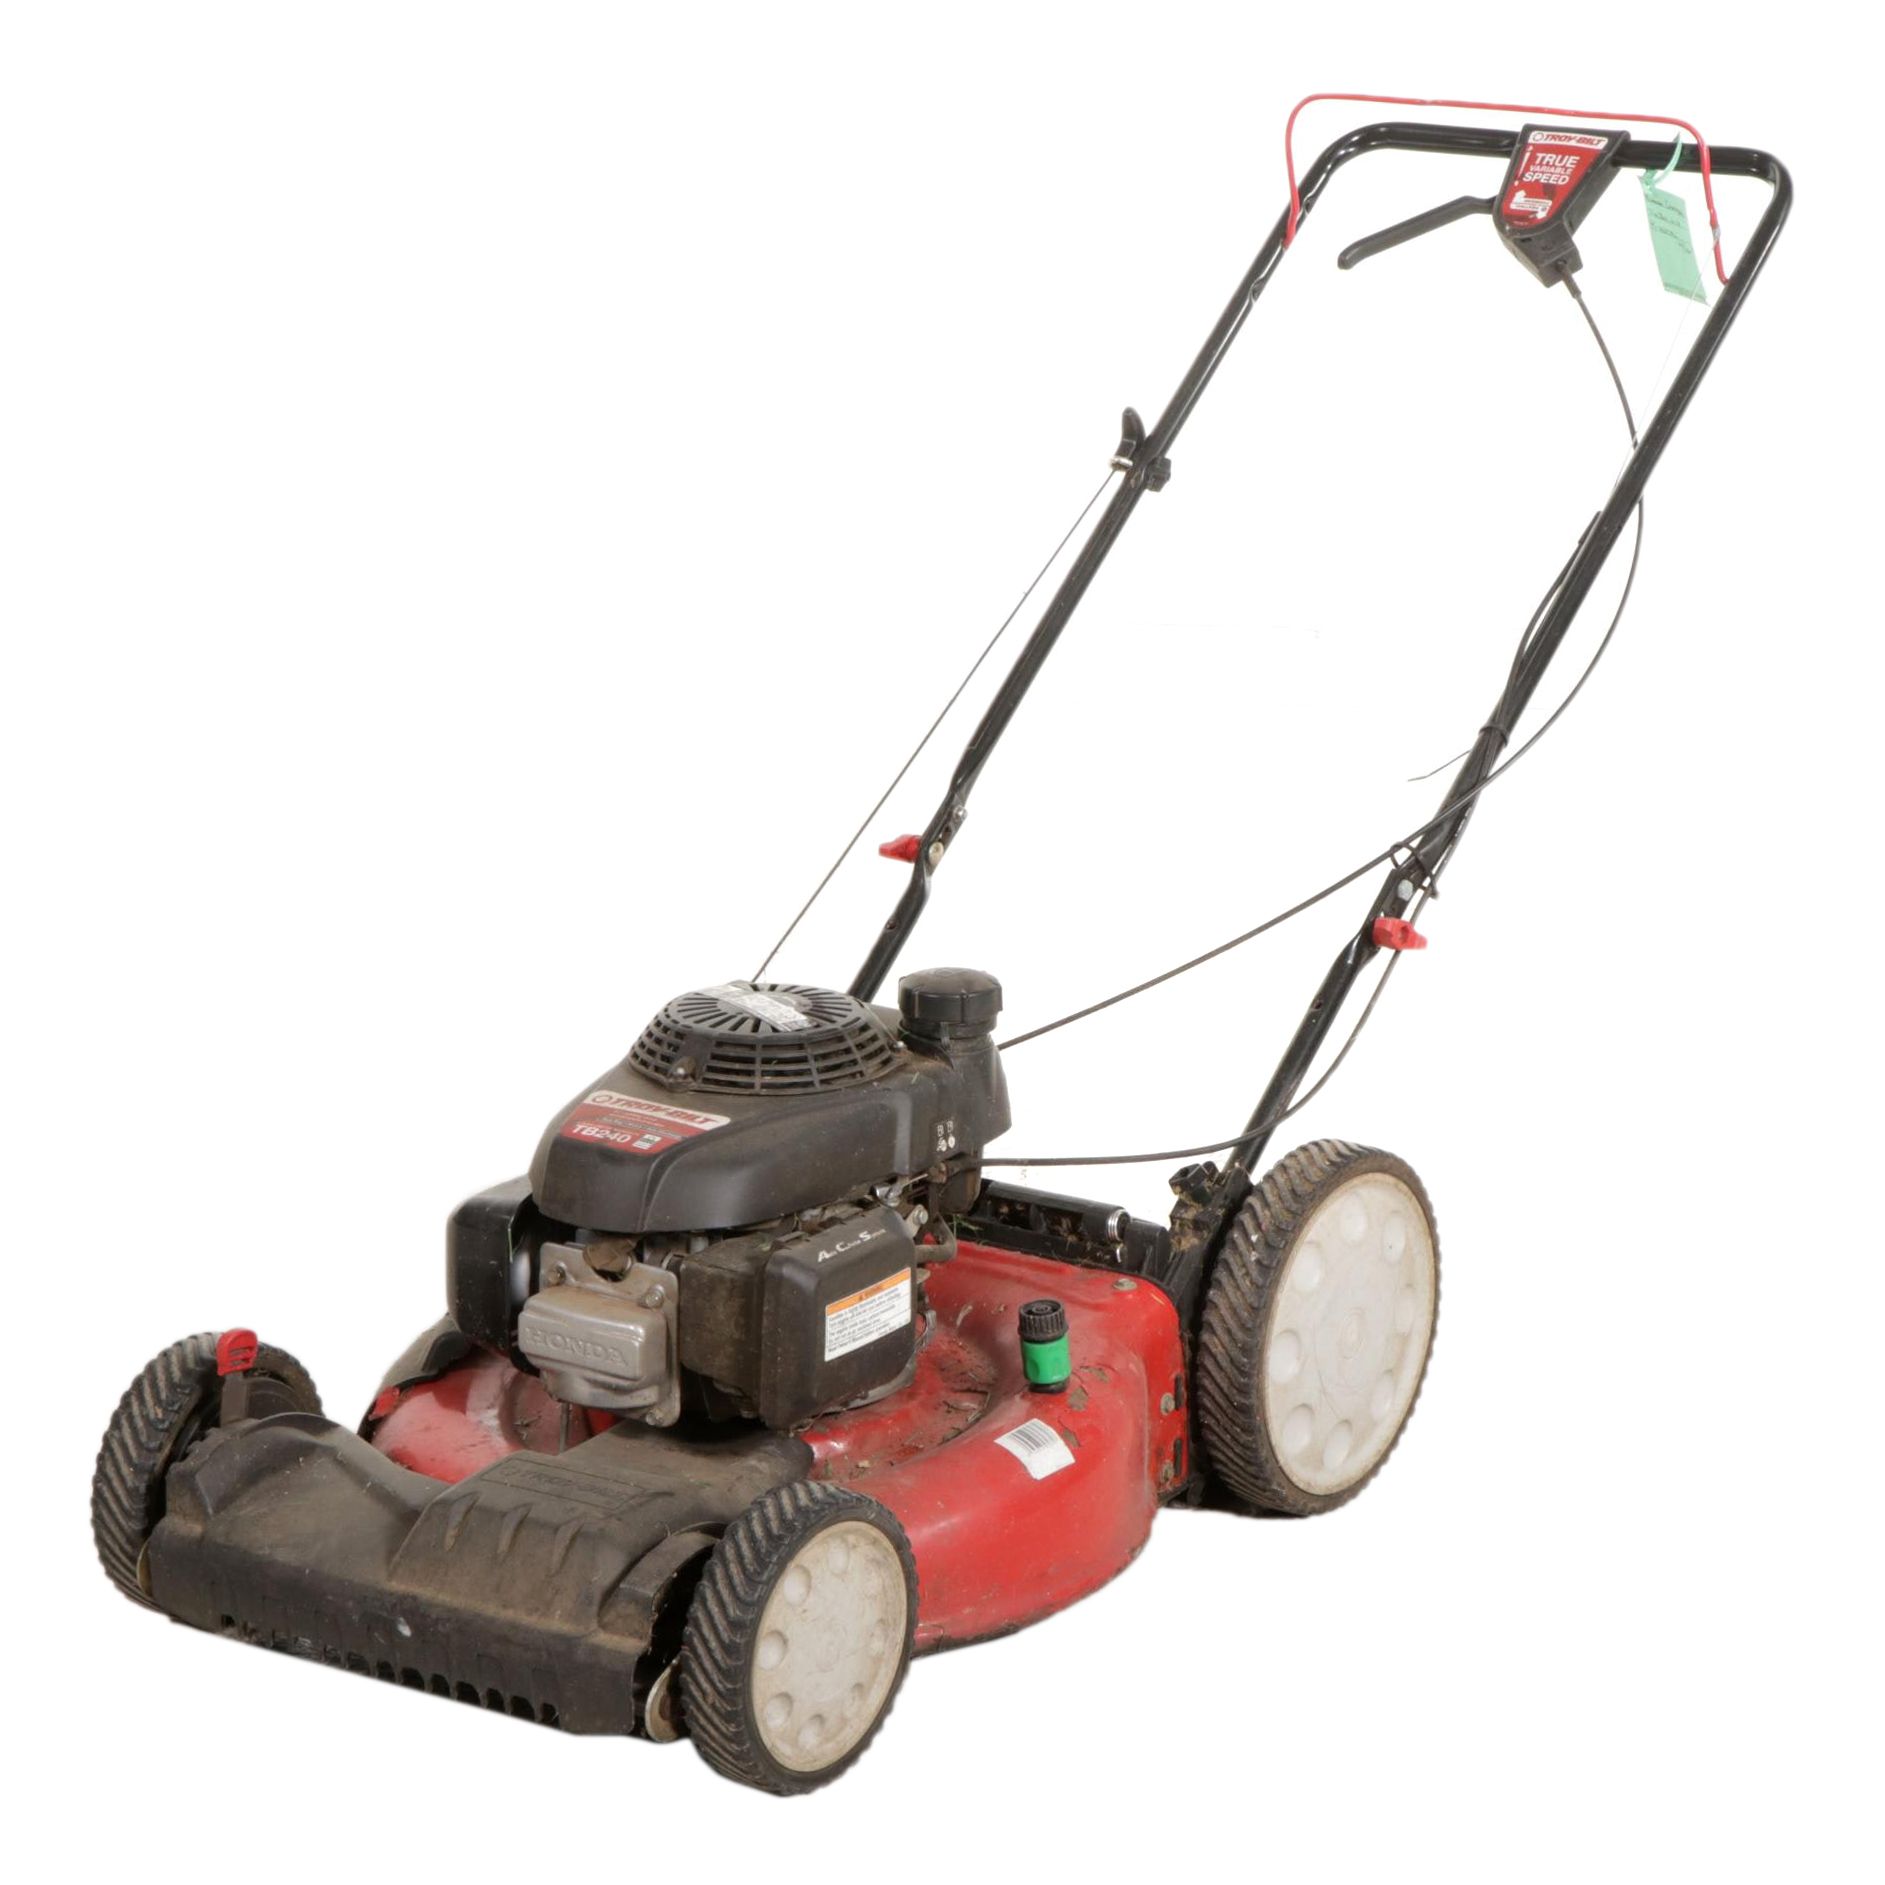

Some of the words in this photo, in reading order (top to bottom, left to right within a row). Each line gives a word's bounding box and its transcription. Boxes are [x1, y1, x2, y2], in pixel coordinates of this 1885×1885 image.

[1543, 133, 1606, 148] TROY-BILT
[1535, 153, 1580, 167] TRUE
[1530, 165, 1574, 175] VARIABLE
[1523, 173, 1570, 185] SPEED
[610, 1098, 717, 1125] TROY-BILT
[572, 1124, 631, 1144] TB240
[525, 1327, 628, 1367] HONDA
